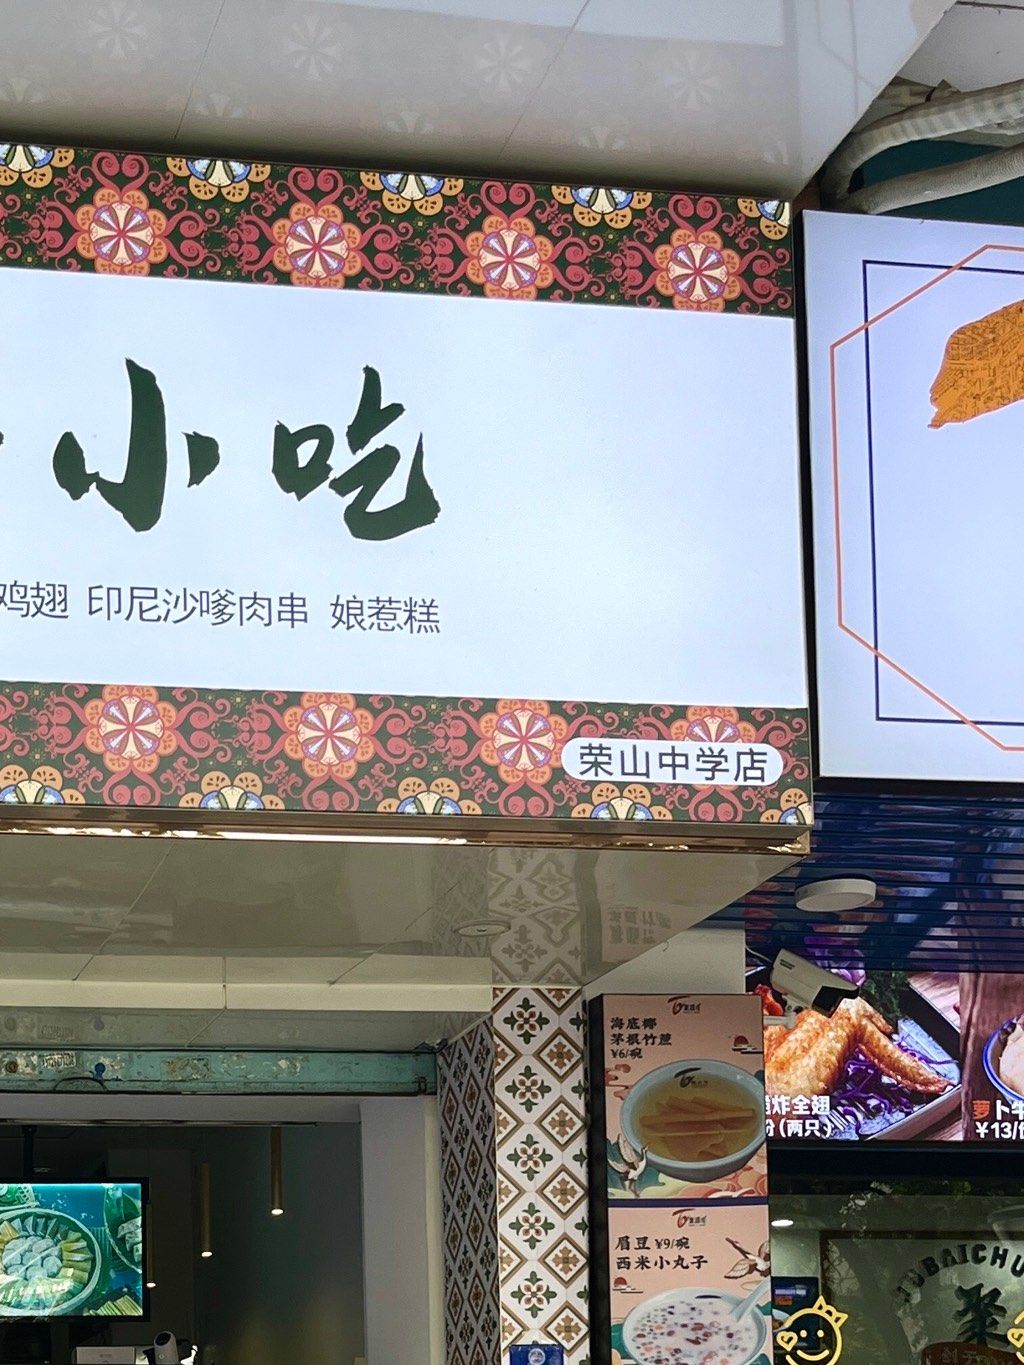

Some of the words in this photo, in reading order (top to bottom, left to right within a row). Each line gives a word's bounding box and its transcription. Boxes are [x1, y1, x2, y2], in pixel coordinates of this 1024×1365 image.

[88, 583, 309, 631] 印尼沙嗲肉串
[329, 593, 442, 635] 娘惹糕
[579, 742, 769, 784] 荣山中学店
[615, 1235, 651, 1251] 眉豆
[615, 1255, 709, 1271] 西米小丸子
